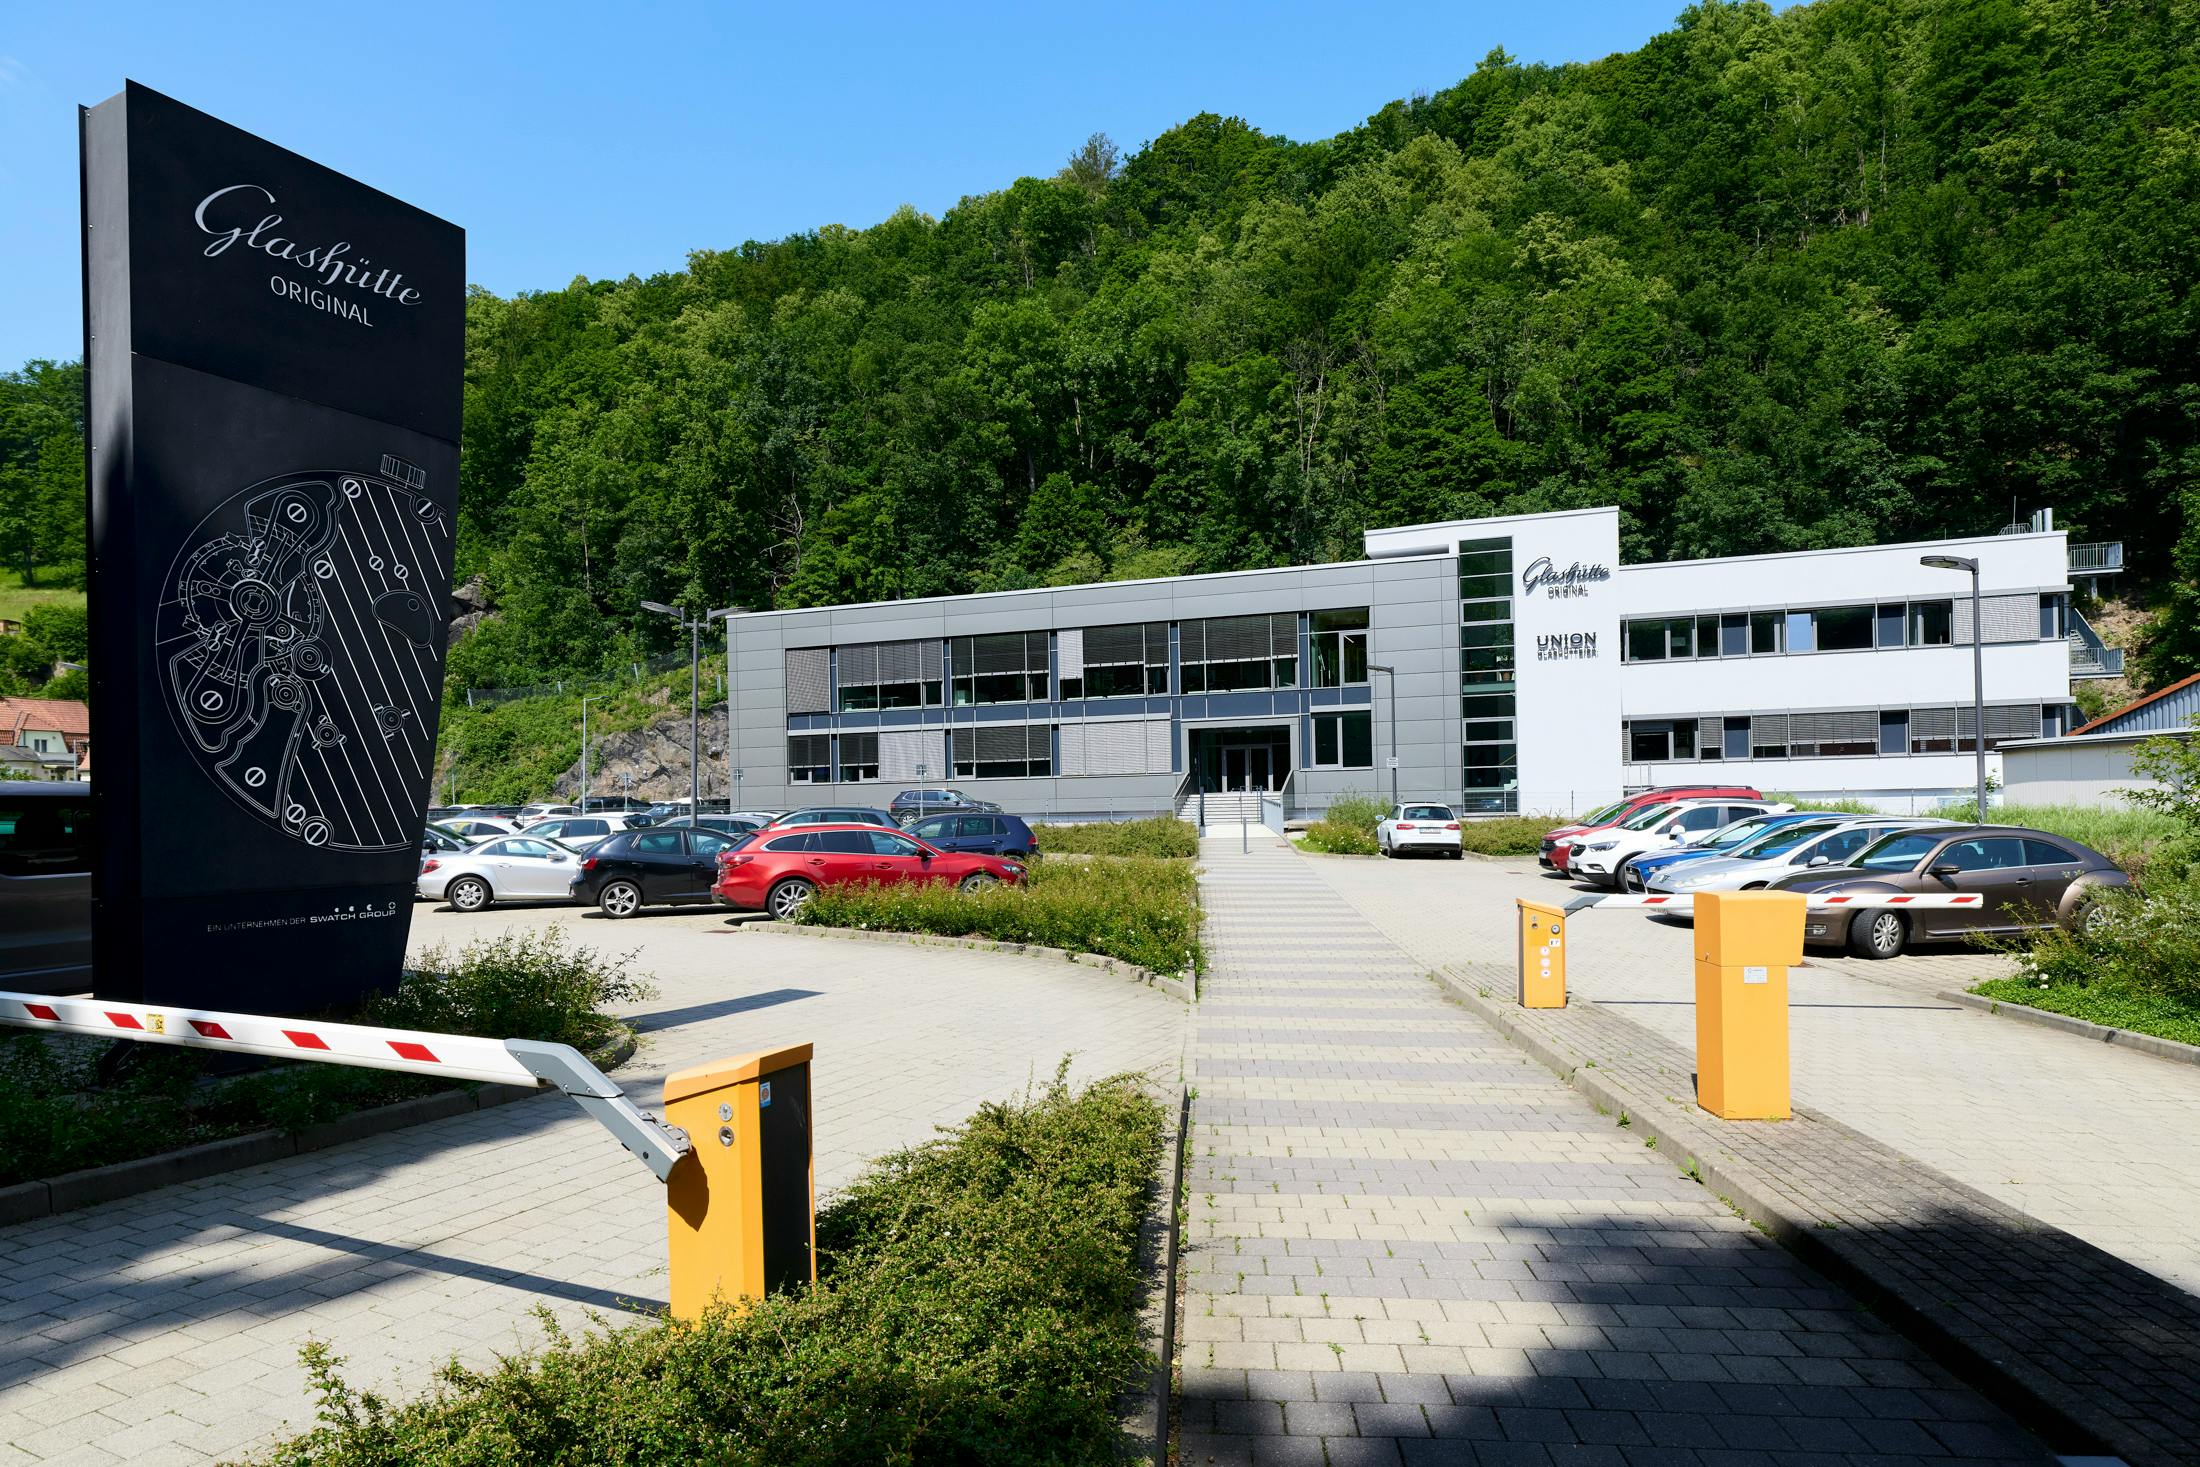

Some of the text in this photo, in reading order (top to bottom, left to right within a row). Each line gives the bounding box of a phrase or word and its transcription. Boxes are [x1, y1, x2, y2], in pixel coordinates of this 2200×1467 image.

[194, 184, 422, 306] Glashütte
[270, 275, 373, 327] ORIGINAL
[1522, 556, 1610, 592] Glashütte
[1547, 584, 1588, 598] ORIGINAL
[1536, 632, 1597, 648] UNION
[207, 910, 396, 932] EIN UNTERNEHMEN DER SWATCH GROUP
